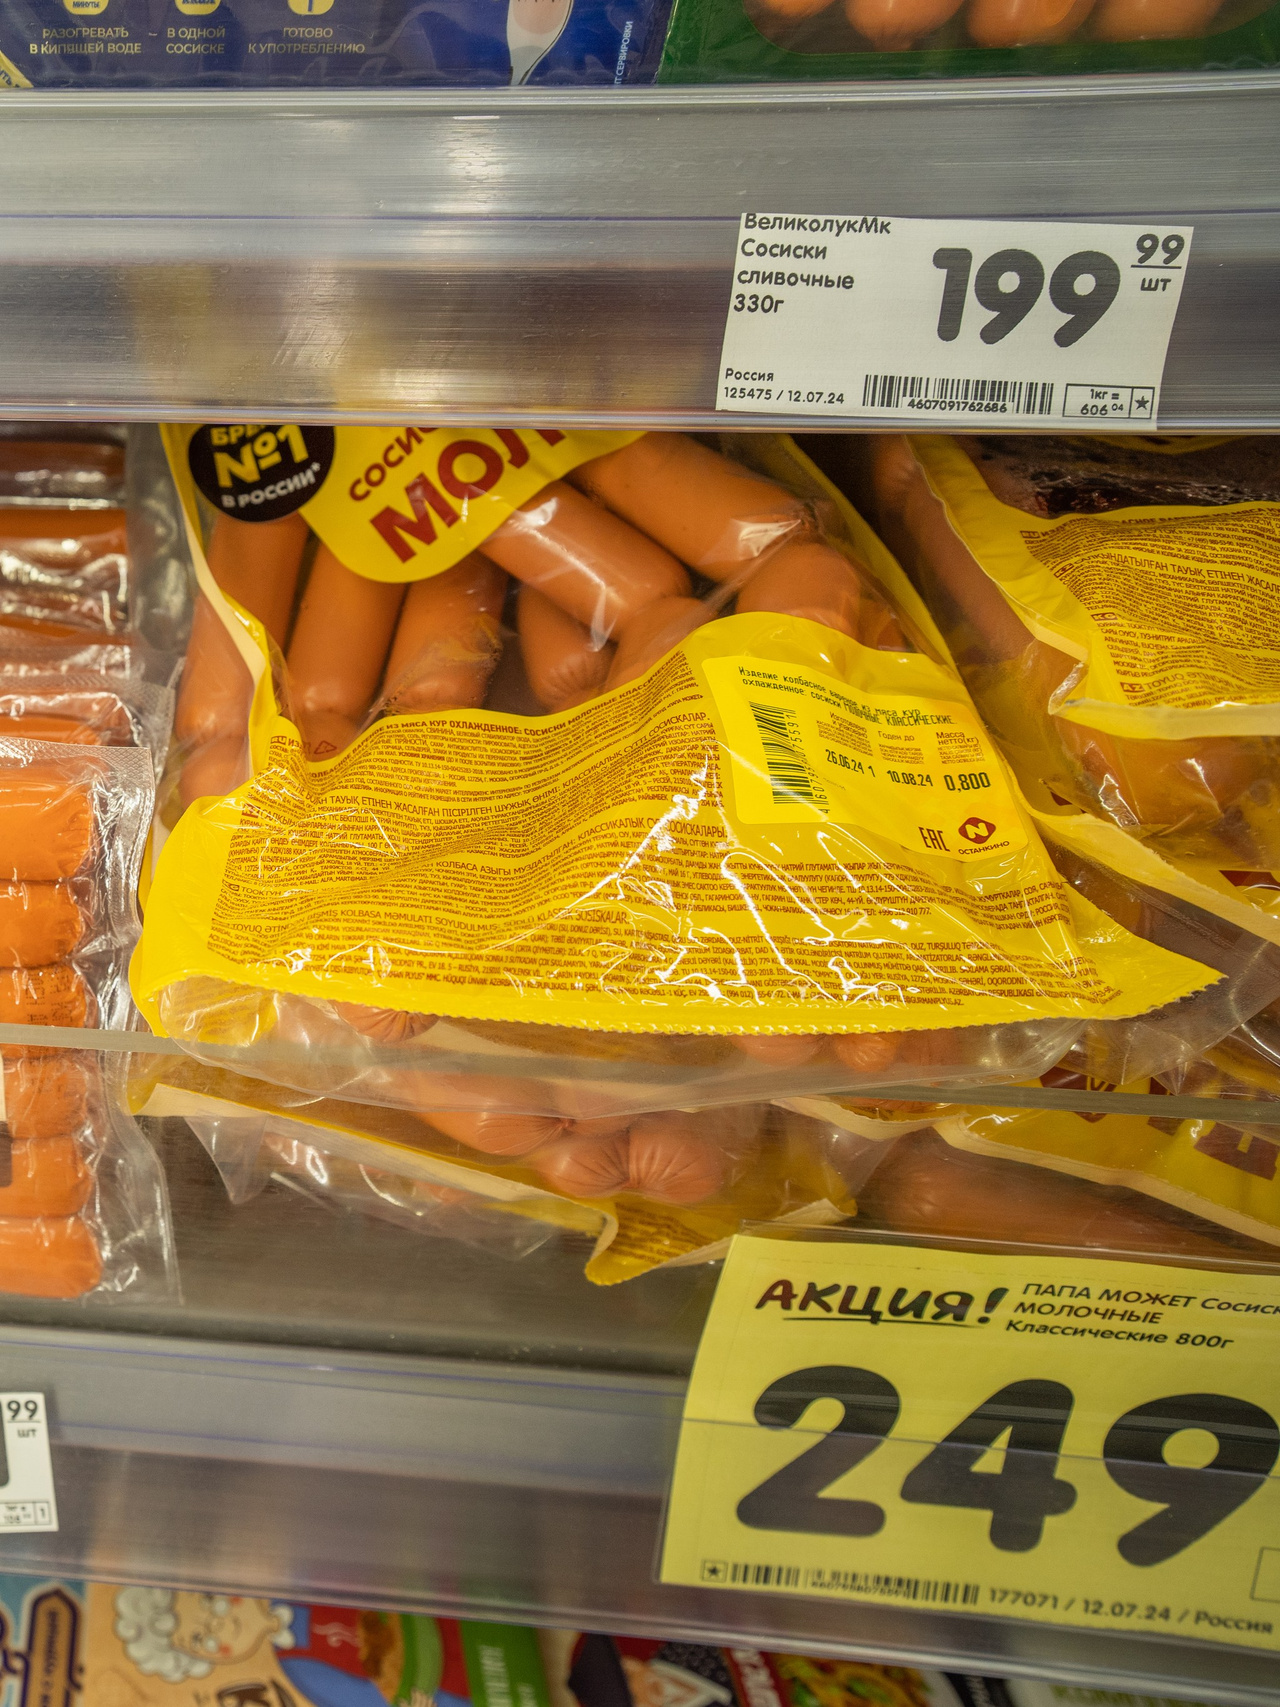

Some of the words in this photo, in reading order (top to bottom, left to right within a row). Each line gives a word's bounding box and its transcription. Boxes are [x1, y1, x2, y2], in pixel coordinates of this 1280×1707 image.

[42, 27, 129, 39] РАЗОГРЕВАТЬ
[168, 28, 175, 38] В
[178, 25, 226, 41] ОДНОЙ
[283, 27, 333, 39] ГОТОВО
[30, 44, 38, 54] В
[41, 41, 104, 55] КИПЯЩЕЙ
[108, 43, 142, 56] ВОДЕ
[166, 43, 225, 55] СОСИСКЕ
[248, 44, 256, 54] К
[259, 43, 366, 56] УПОТРЕБЛЕНИЮ
[614, 21, 634, 77] СЕРВИРОВКИ
[744, 213, 892, 238] ВеликолукМк
[741, 238, 828, 261] Сосиски
[737, 269, 855, 290] сливочные
[1140, 277, 1171, 292] шт
[932, 247, 1121, 348] 199
[1136, 233, 1185, 265] 99
[733, 293, 784, 314] 330г
[725, 367, 775, 383] Россия
[724, 386, 773, 400] 125475
[787, 389, 845, 405] 12.07.24
[1090, 388, 1109, 401] 1кг
[907, 398, 1009, 414] 4607091762686
[1080, 403, 1109, 417] 606
[1111, 403, 1124, 413] 04
[222, 493, 235, 508] В
[401, 720, 428, 729] МЯСА
[429, 719, 448, 728] КУР
[449, 720, 523, 736] ОХЛАЖДЕННОЕ:
[524, 721, 567, 737] СОСИСКИ
[568, 696, 618, 726] МОЛОЧНЫЕ
[618, 650, 684, 700] КЛАССИЧЕСКИЕ.
[783, 675, 827, 694] колбасное
[878, 731, 902, 742] Годен
[936, 731, 965, 740] Масса
[938, 737, 980, 745] нетто(кг)
[825, 748, 865, 775] 26.06.24
[886, 769, 934, 787] 10.08.24
[943, 771, 991, 793] 0,800
[436, 860, 478, 872] КОЛБАСА
[577, 818, 645, 841] КЛАССИКАЛЫК
[667, 821, 728, 839] ОСИСКАЛАРЫ.
[958, 840, 1010, 855] ОСТАНКИНО
[232, 922, 263, 935] TOYUQ
[340, 909, 382, 921] KOLBASA
[384, 911, 433, 926] MƏMULATI
[755, 1278, 1009, 1326] АКЦИЯ!
[1022, 1283, 1091, 1300] ПАПА
[1098, 1289, 1197, 1309] МОЖЕТ
[1014, 1302, 1164, 1325] МОЛОЧНЫЕ
[1005, 1320, 1168, 1344] Классические
[1175, 1333, 1234, 1350] 800г
[7, 1400, 38, 1421] 99
[736, 1364, 1280, 1567] 249
[987, 1588, 1059, 1610] 177071
[1081, 1597, 1172, 1623] 12.07.24
[1193, 1610, 1274, 1636] Россия
